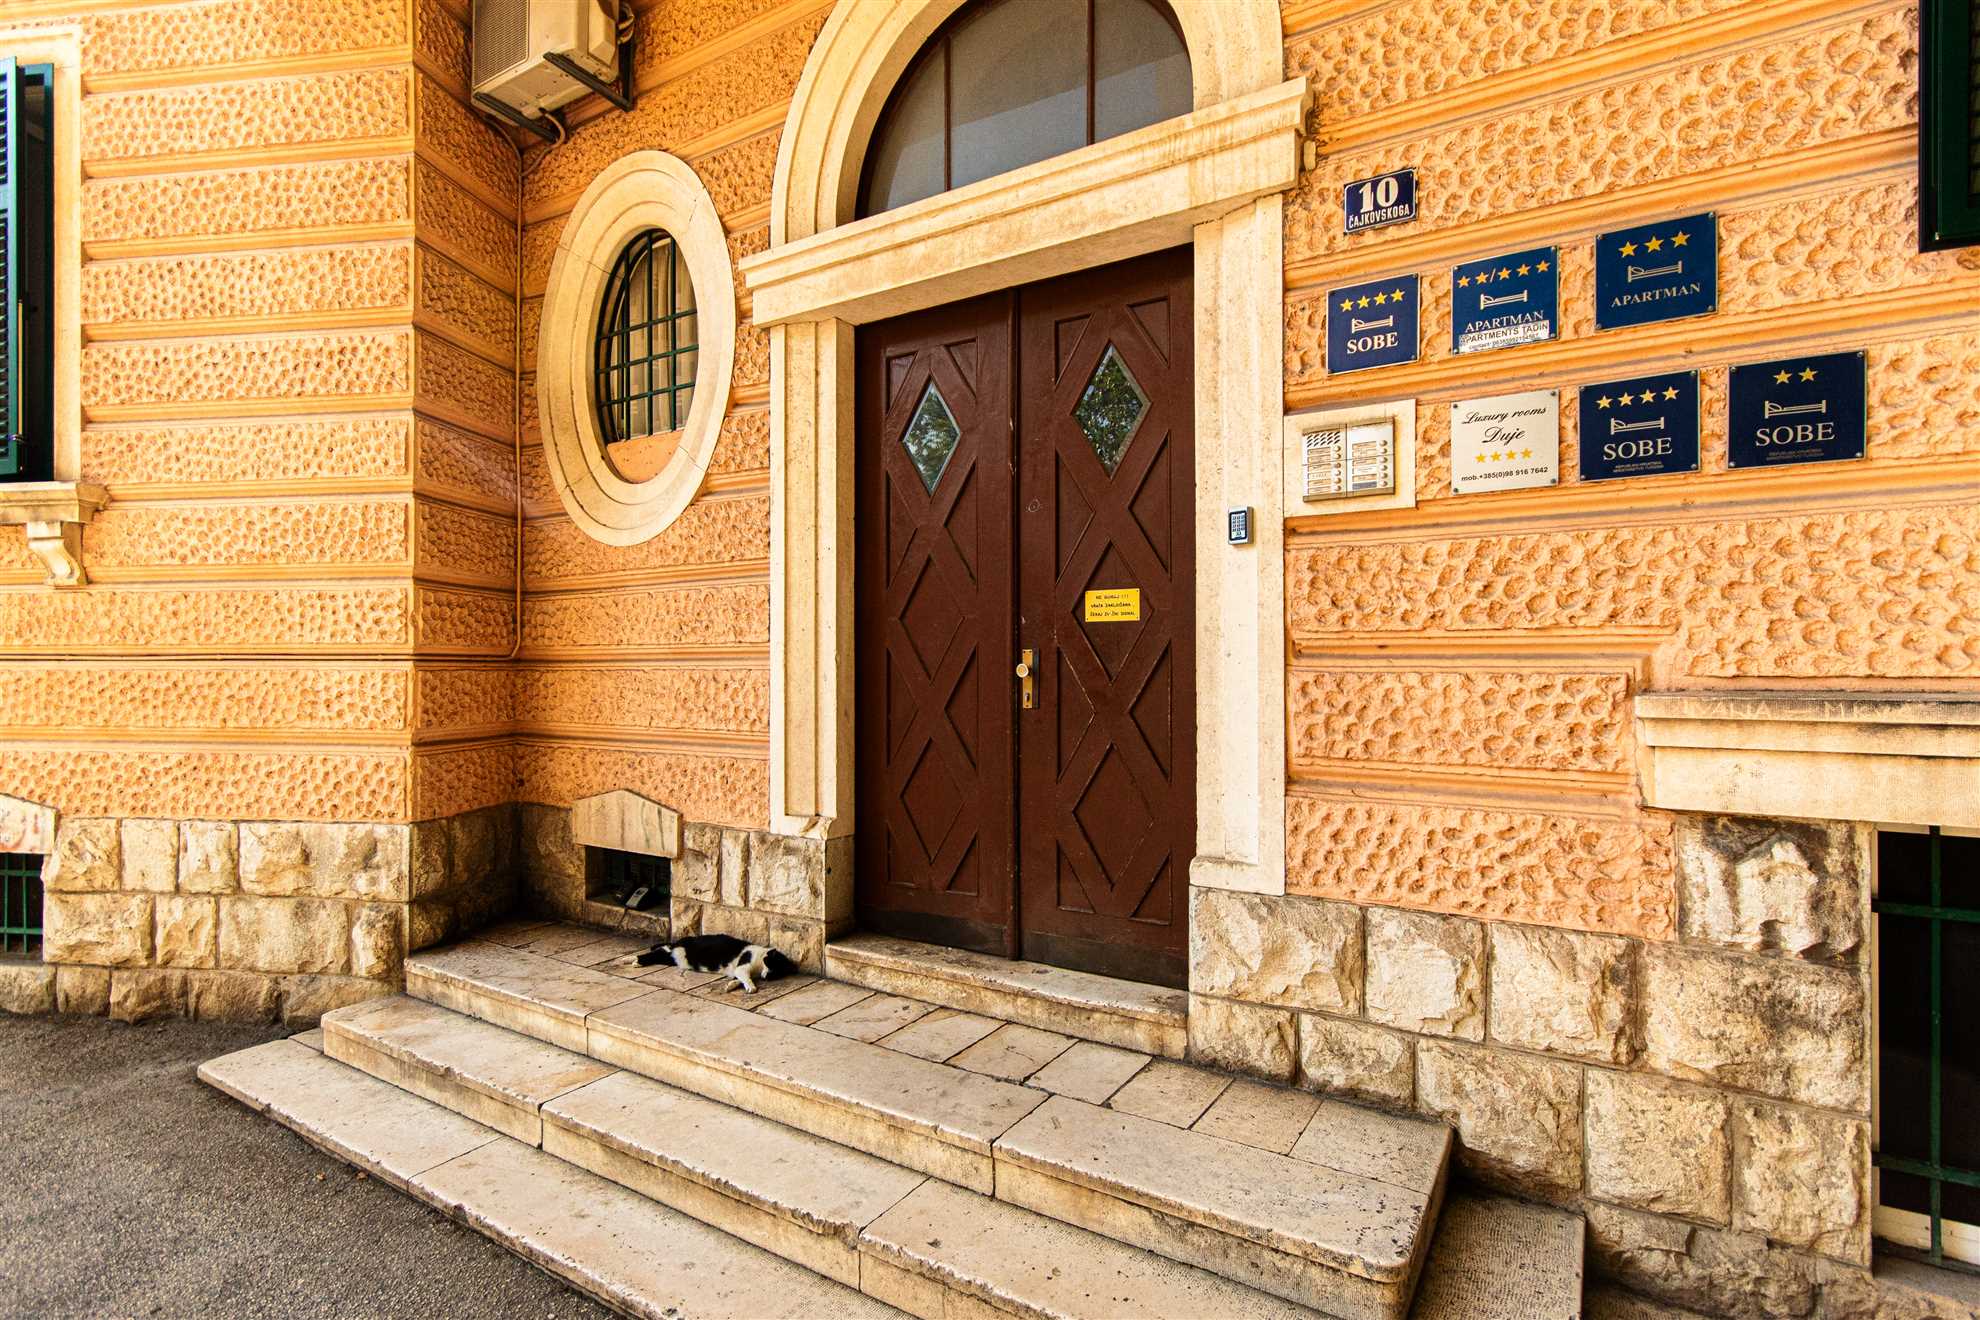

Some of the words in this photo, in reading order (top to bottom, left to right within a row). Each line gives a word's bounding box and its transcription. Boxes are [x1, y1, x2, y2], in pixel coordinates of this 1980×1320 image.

[1359, 177, 1399, 213] 10
[1348, 204, 1410, 229] ČAJKOVSKOGA
[1611, 282, 1701, 308] APARTMAN
[1464, 310, 1544, 333] APARTMAN
[1346, 332, 1399, 354] SOBE
[1460, 328, 1519, 345] APARTMENTS
[1461, 411, 1509, 424] Luxury
[1511, 406, 1547, 418] rooms
[1481, 426, 1526, 446] Duje
[1755, 422, 1836, 447] SOBE
[1602, 437, 1673, 461] SOBE
[1515, 468, 1529, 476] 916
[1530, 466, 1549, 474] 7642
